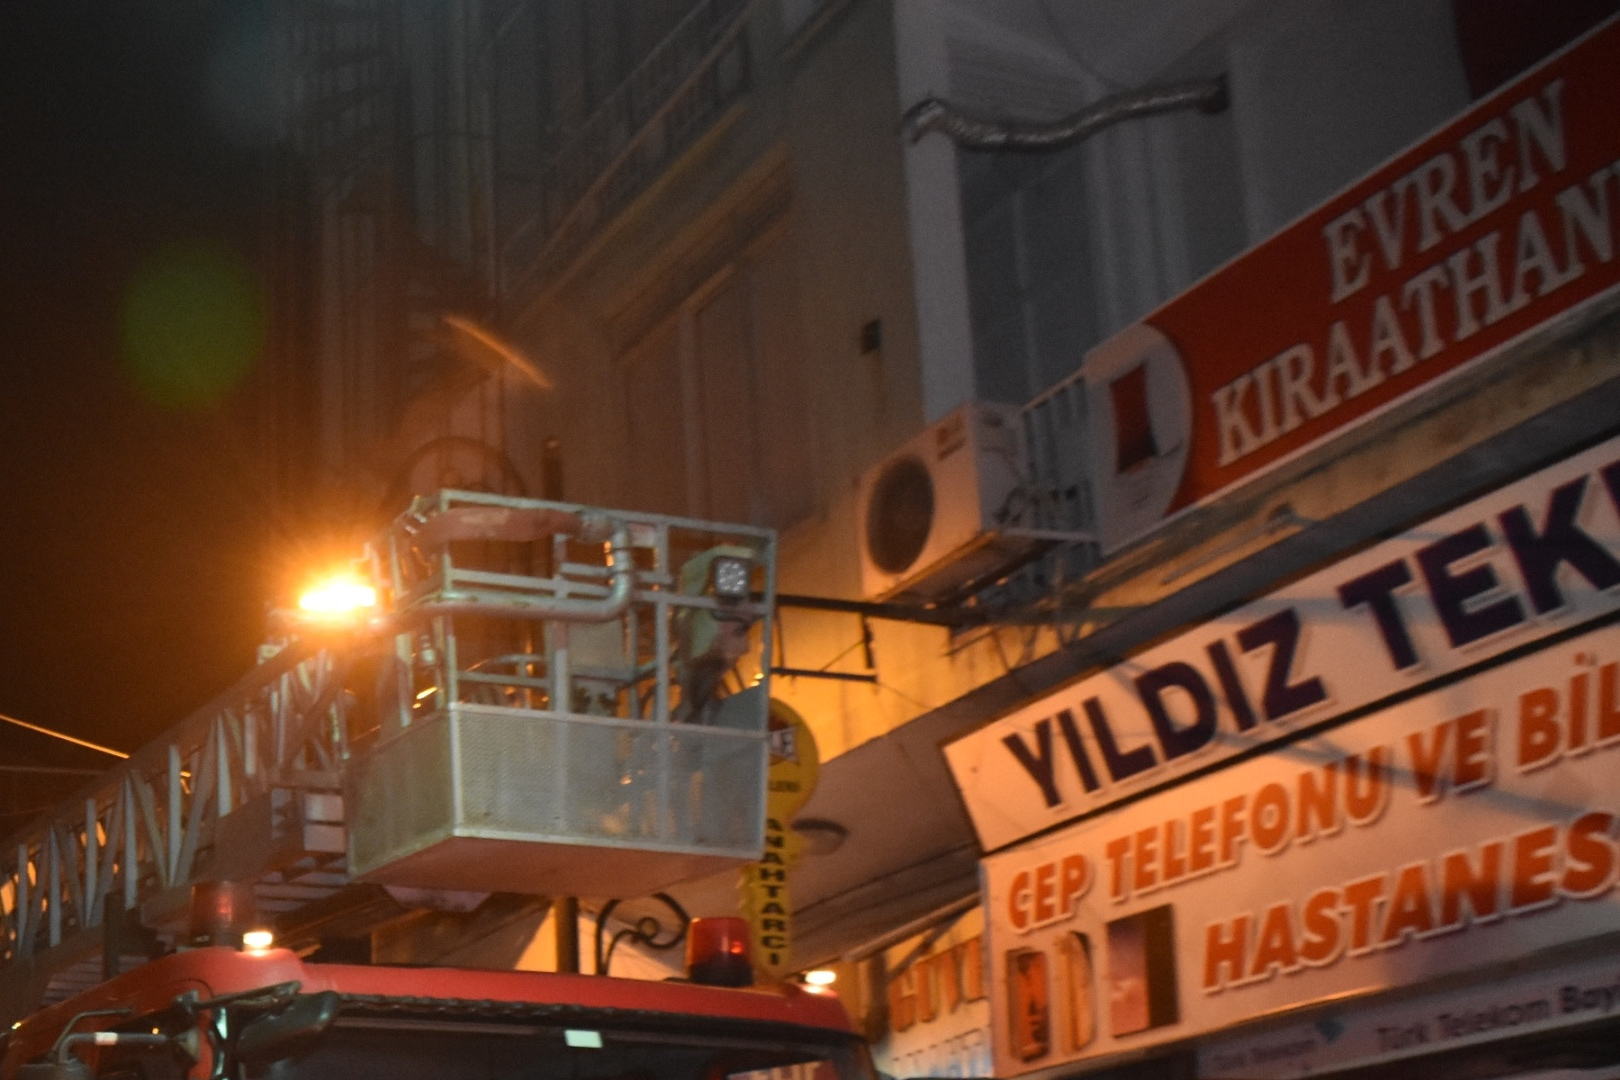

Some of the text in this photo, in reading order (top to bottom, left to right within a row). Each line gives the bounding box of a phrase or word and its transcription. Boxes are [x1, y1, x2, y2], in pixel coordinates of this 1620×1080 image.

[1322, 77, 1568, 303] EVREN
[1002, 459, 1620, 810] YILDIZ TEK
[1006, 853, 1090, 932] CEP
[1106, 750, 1390, 904] TELEFONU
[1405, 708, 1492, 804] VE
[1201, 812, 1620, 994] HASTANES
